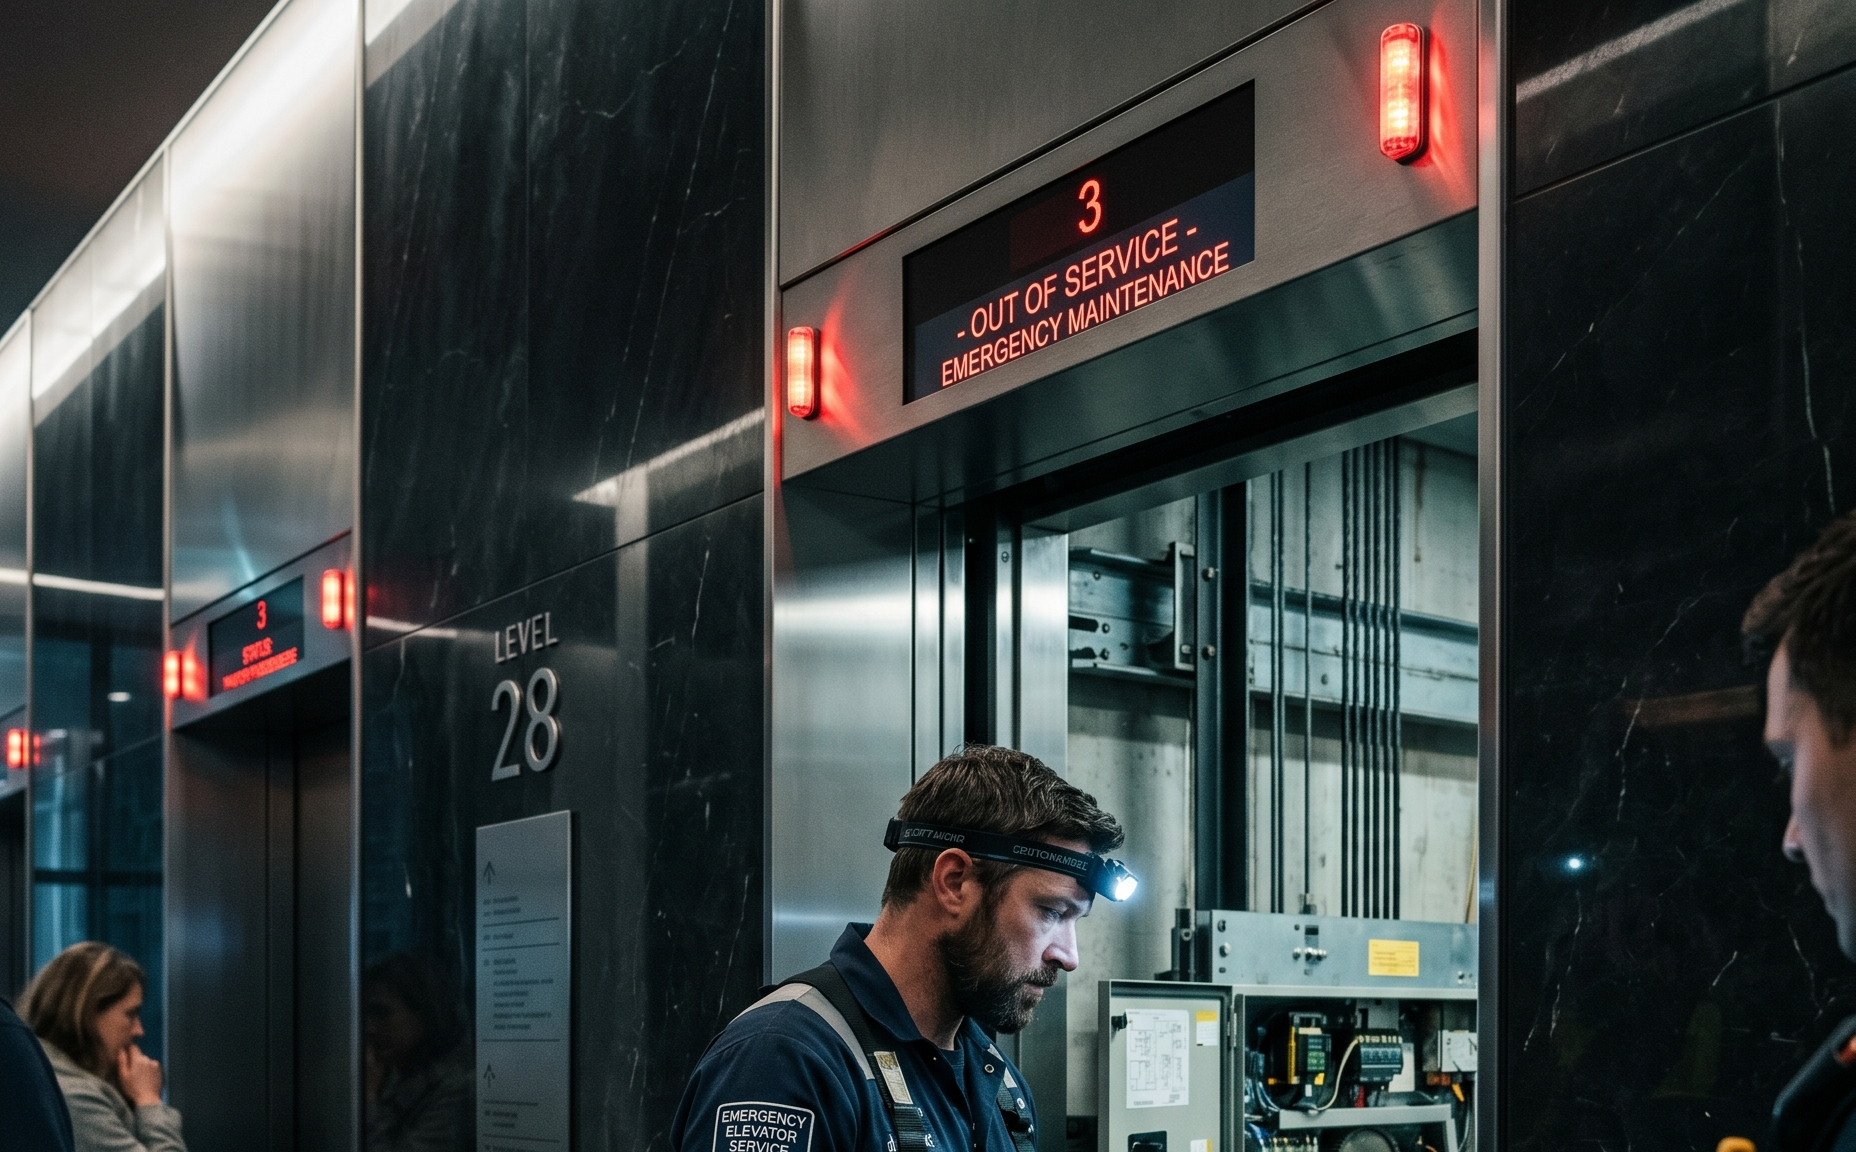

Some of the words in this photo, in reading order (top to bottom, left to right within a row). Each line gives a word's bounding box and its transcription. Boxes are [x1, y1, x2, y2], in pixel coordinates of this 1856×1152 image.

[1078, 179, 1102, 233] 3
[971, 291, 1019, 337] OUT
[1024, 274, 1057, 314] OF
[1064, 218, 1179, 297] SERVICE
[942, 312, 1062, 386] EMERGENCY
[1068, 242, 1229, 333] MAINTENANCE
[257, 600, 267, 629] 3
[495, 612, 558, 663] LEVEL
[491, 667, 560, 782] 28
[721, 1109, 807, 1129] EMERGENCY
[725, 1125, 797, 1143] ELEVATOR
